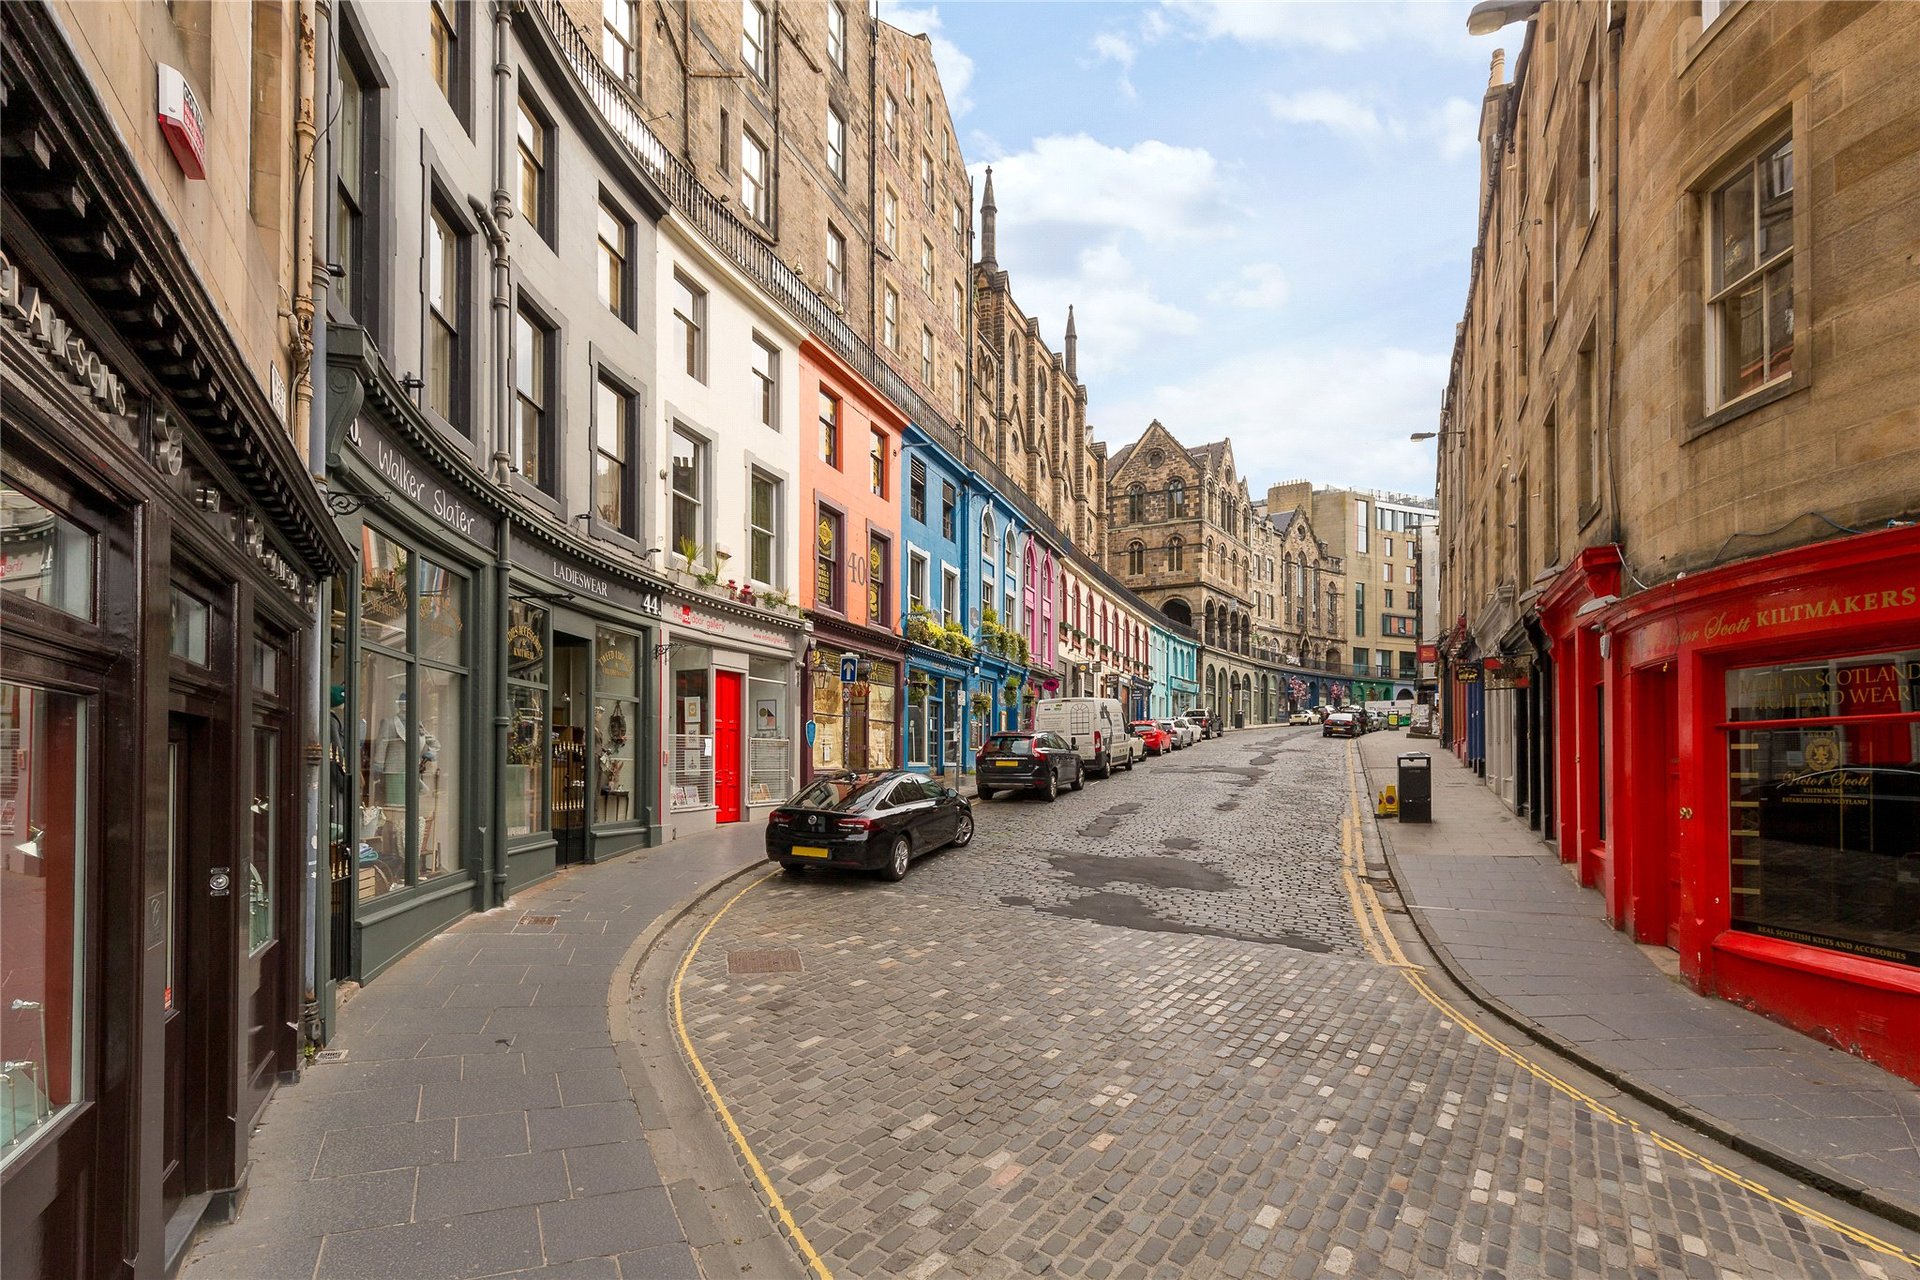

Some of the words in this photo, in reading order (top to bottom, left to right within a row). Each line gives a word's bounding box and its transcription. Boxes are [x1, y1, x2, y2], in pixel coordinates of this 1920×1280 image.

[378, 440, 425, 501] Walker
[433, 488, 475, 534] Slater
[553, 561, 608, 597] LADIESWEAR
[848, 552, 866, 586] 40
[706, 618, 726, 632] gallery
[1704, 611, 1751, 644] Scott
[1756, 586, 1917, 628] KILTMAKERS
[1793, 674, 1811, 690] IN
[1815, 662, 1920, 688] SCOTLAND
[1850, 684, 1911, 705] WEAR
[1830, 771, 1870, 787] Scott
[1781, 796, 1822, 804] ESTABLISHED
[1832, 798, 1869, 806] SCOTLAND
[1757, 924, 1775, 935] REAL
[1776, 928, 1811, 943] SCOTTISH
[1812, 935, 1834, 946] KILTS
[1835, 940, 1853, 951] AND
[1854, 944, 1907, 961] ACCESORIES
